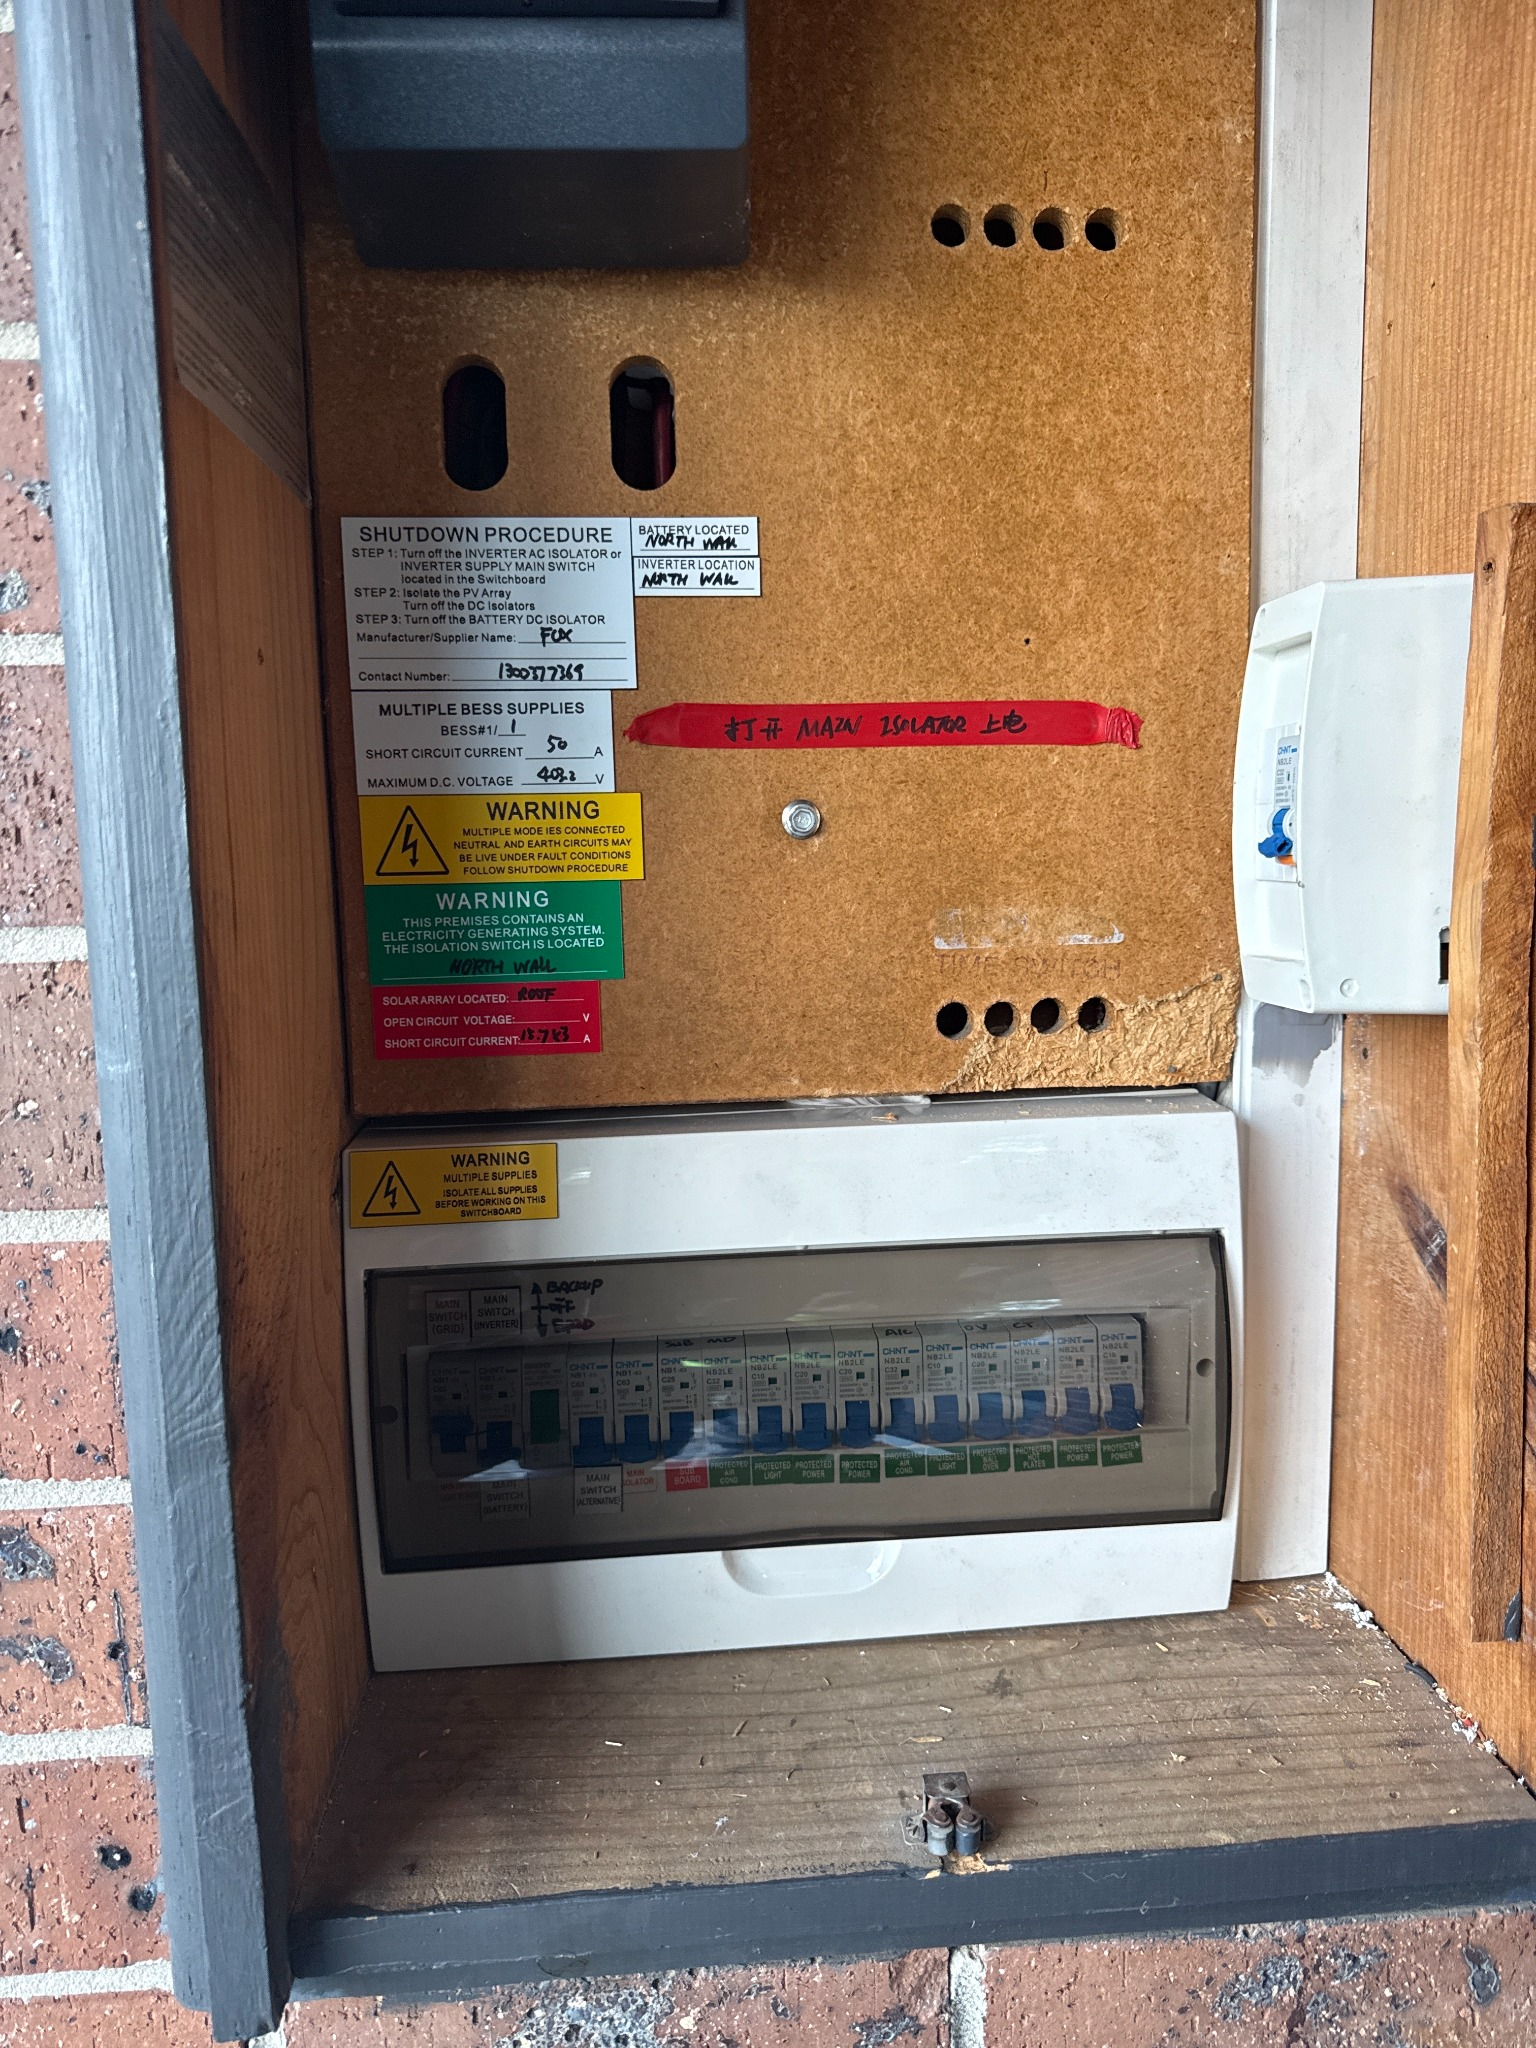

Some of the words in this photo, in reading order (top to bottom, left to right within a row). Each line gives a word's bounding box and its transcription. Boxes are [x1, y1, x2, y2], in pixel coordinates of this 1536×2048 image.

[360, 527, 478, 542] SHUTDOWN
[486, 527, 612, 543] PROCEDURE
[639, 525, 692, 534] BATTERY
[695, 525, 749, 534] LOCATED
[646, 533, 694, 549] NORTH
[703, 536, 737, 550] WALL
[352, 548, 384, 558] STEP
[388, 549, 397, 558] 1:
[400, 549, 425, 558] Turn
[428, 549, 442, 558] off
[444, 549, 461, 558] the
[465, 550, 528, 558] INVERTER
[529, 550, 545, 558] AC
[548, 550, 608, 558] ISOLATOR
[401, 562, 462, 571] INVERTER
[465, 562, 512, 571] SUPPLY
[515, 562, 544, 571] MAIN
[548, 562, 594, 571] SWITCH
[638, 560, 695, 569] INVERTER
[698, 560, 754, 570] LOCATION
[402, 574, 442, 584] located
[444, 574, 456, 584] in
[458, 574, 474, 584] the
[478, 575, 545, 584] Switchboard
[700, 572, 738, 586] WALL
[354, 588, 388, 597] STEP
[390, 589, 399, 597] 2:
[403, 589, 440, 598] Isolate
[443, 589, 460, 598] the
[463, 589, 479, 598] PV
[482, 589, 511, 600] Array
[404, 602, 428, 610] Turn
[430, 601, 444, 610] off
[447, 602, 464, 610] the
[468, 602, 484, 610] DC
[488, 602, 535, 611] Isolators
[356, 615, 388, 624] STEP
[392, 615, 401, 624] 3:
[405, 615, 427, 624] Turn
[430, 615, 446, 624] off
[449, 615, 466, 624] the
[469, 615, 523, 624] BATTERY
[526, 615, 543, 624] DC
[546, 615, 605, 624] ISOLATOR
[356, 632, 478, 644] Manufacturer/Supplier
[482, 633, 516, 642] Name:
[359, 672, 402, 682] Contact
[405, 672, 450, 681] Number:
[379, 704, 457, 716] MULTIPLE
[461, 703, 502, 715] BESS
[507, 702, 584, 714] SUPPLIES
[440, 725, 498, 736] BESS#1/
[724, 717, 783, 742] 打开
[548, 735, 568, 754] 50
[366, 749, 408, 759] SHORT
[412, 748, 462, 758] CIRCUIT
[464, 747, 523, 757] CURRENT
[594, 747, 603, 756] A
[368, 778, 426, 788] MAXIMUM
[430, 778, 454, 788] D.C.
[458, 776, 513, 787] VOLTAGE
[595, 774, 604, 784] V
[486, 801, 599, 820] WARNING
[463, 827, 511, 836] MULTIPLE
[514, 827, 542, 835] MODE
[565, 826, 625, 834] CONNECTED
[454, 840, 499, 849] NEUTRAL
[504, 840, 525, 848] AND
[528, 839, 560, 848] EARTH
[563, 839, 608, 848] CIRCUITS
[611, 838, 632, 847] MAY
[460, 854, 472, 862] BE
[475, 853, 497, 862] LIVE
[500, 852, 535, 861] UNDER
[538, 852, 566, 860] FAULT
[570, 851, 631, 860] CONDITIONS
[464, 865, 505, 874] FOLLOW
[508, 864, 563, 874] SHUTDOWN
[567, 864, 628, 873] PROCEDURE
[436, 890, 549, 910] WARNING
[403, 918, 431, 927] THIS
[435, 916, 499, 927] PREMISES
[502, 914, 564, 925] CONTAINS
[567, 913, 584, 923] AN
[382, 929, 464, 942] ELECTRICITY
[467, 927, 548, 939] GENERATING
[552, 925, 605, 936] SYSTEM.
[384, 944, 409, 954] THE
[412, 942, 478, 953] ISOLATION
[481, 940, 530, 951] SWITCH
[533, 939, 545, 949] IS
[548, 938, 604, 949] LOCATED
[450, 959, 504, 974] NORTH
[513, 956, 556, 973] WALL
[383, 996, 419, 1005] SOLAR
[421, 995, 455, 1005] ARRAY
[458, 994, 509, 1004] LOCATED:
[518, 987, 556, 1002] ROOF
[384, 1017, 413, 1027] OPEN
[416, 1017, 458, 1026] CIRCUIT
[464, 1015, 515, 1025] VOLTAGE:
[582, 1014, 590, 1022] V
[385, 1039, 421, 1049] SHORT
[424, 1038, 466, 1047] CIRCUIT
[583, 1034, 590, 1043] A
[451, 1151, 530, 1167] WARNING
[444, 1173, 489, 1183] MULTIPLE
[491, 1170, 537, 1181] SUPPLIES
[443, 1188, 479, 1197] ISOLATE
[498, 1185, 537, 1194] SUPPLIES
[435, 1200, 469, 1208] BEFORE
[472, 1198, 511, 1206] WORKING
[460, 1208, 521, 1217] SWITCHBOARD
[484, 1295, 508, 1304] MAIN
[429, 1312, 467, 1322] SWITCH
[478, 1307, 515, 1317] SWITCH
[474, 1319, 518, 1330] (INVERTER)
[755, 1462, 791, 1470] PROTECTED
[795, 1461, 832, 1469] PROTECTED
[586, 1474, 609, 1482] MAIN
[764, 1471, 782, 1479] LIGHT
[802, 1470, 825, 1478] POWER
[674, 1476, 700, 1485] BOARD
[581, 1486, 616, 1495] SWITCH
[576, 1497, 620, 1507] (ALTERNATIVE)
